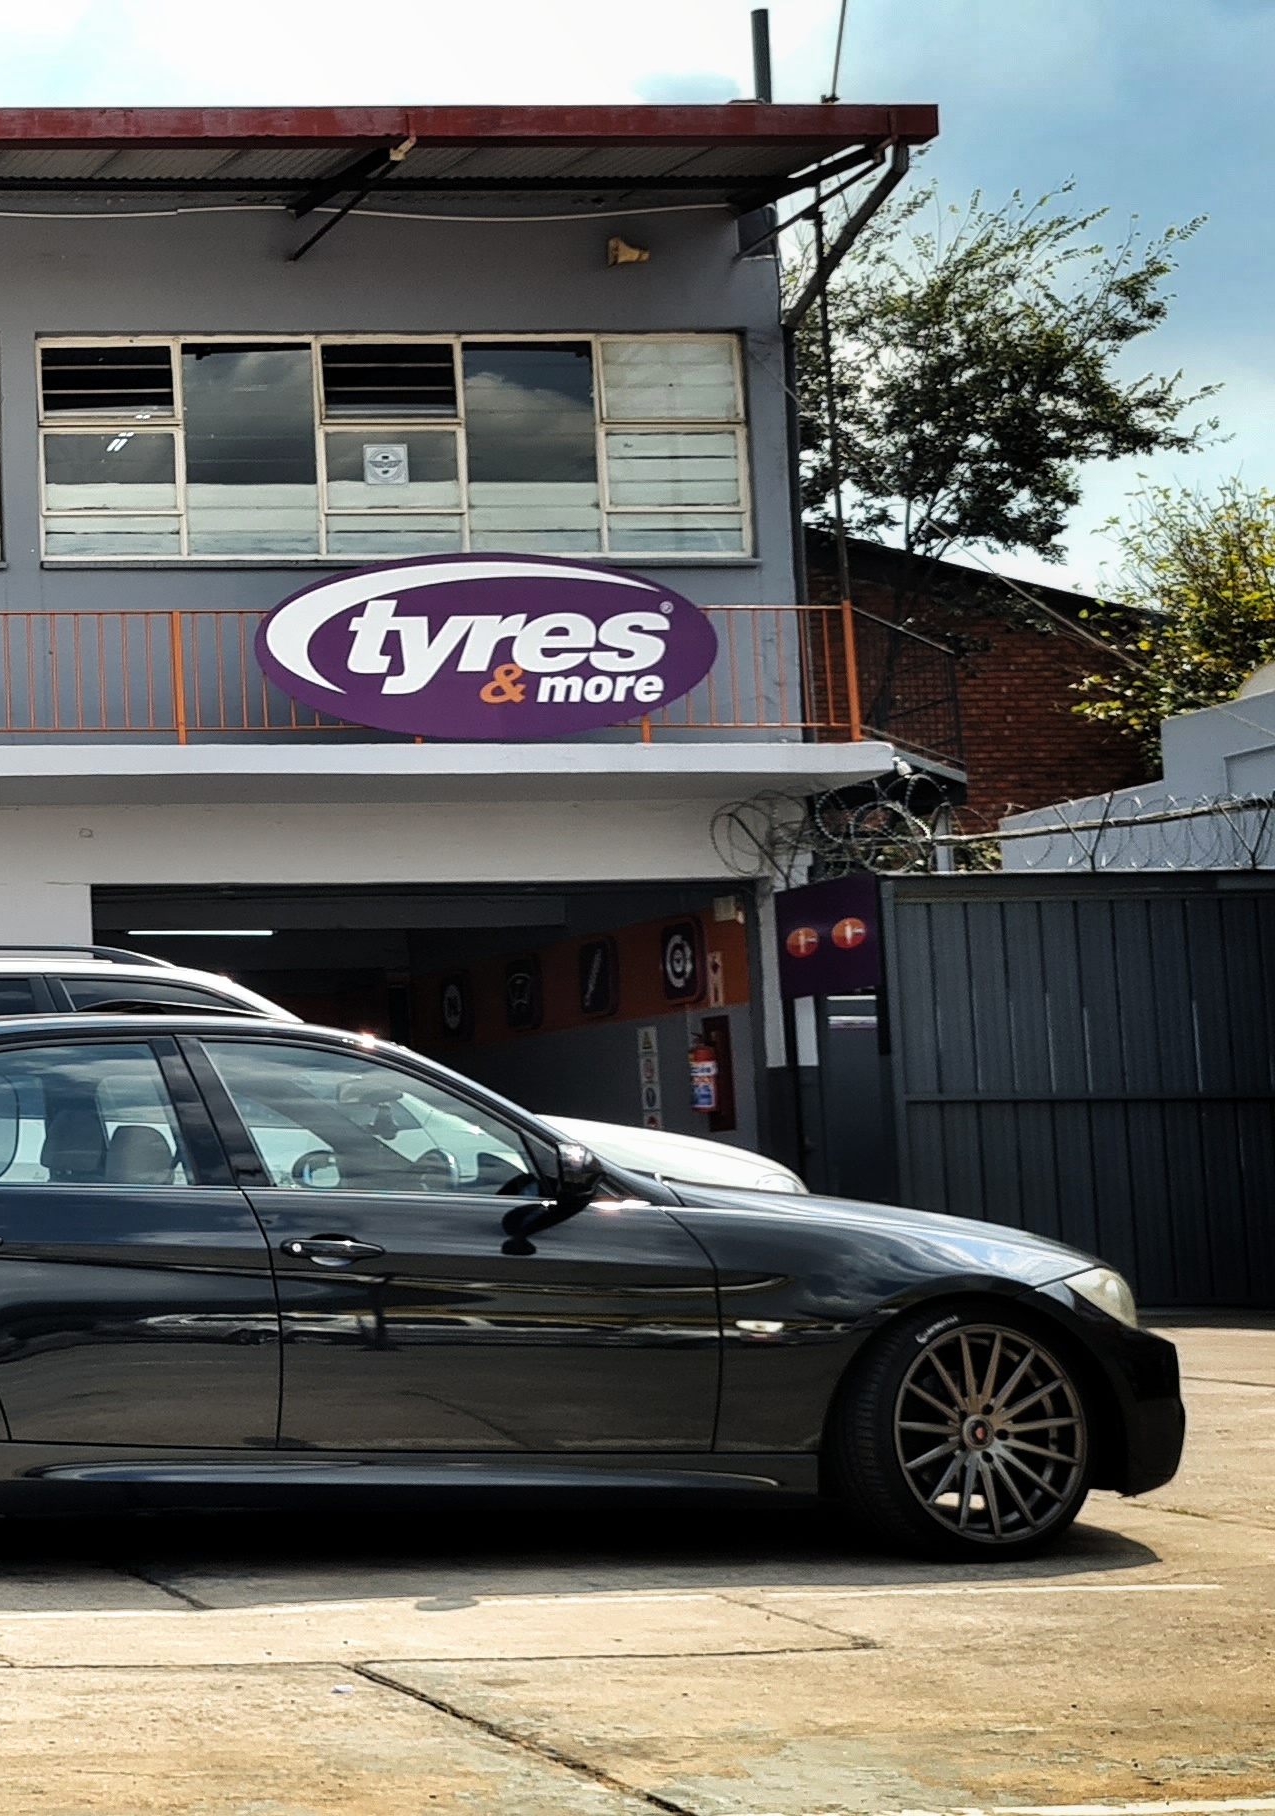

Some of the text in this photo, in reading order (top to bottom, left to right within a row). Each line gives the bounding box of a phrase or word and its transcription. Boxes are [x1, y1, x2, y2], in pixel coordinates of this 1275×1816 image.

[347, 599, 671, 696] tyres
[479, 663, 665, 704] & more
